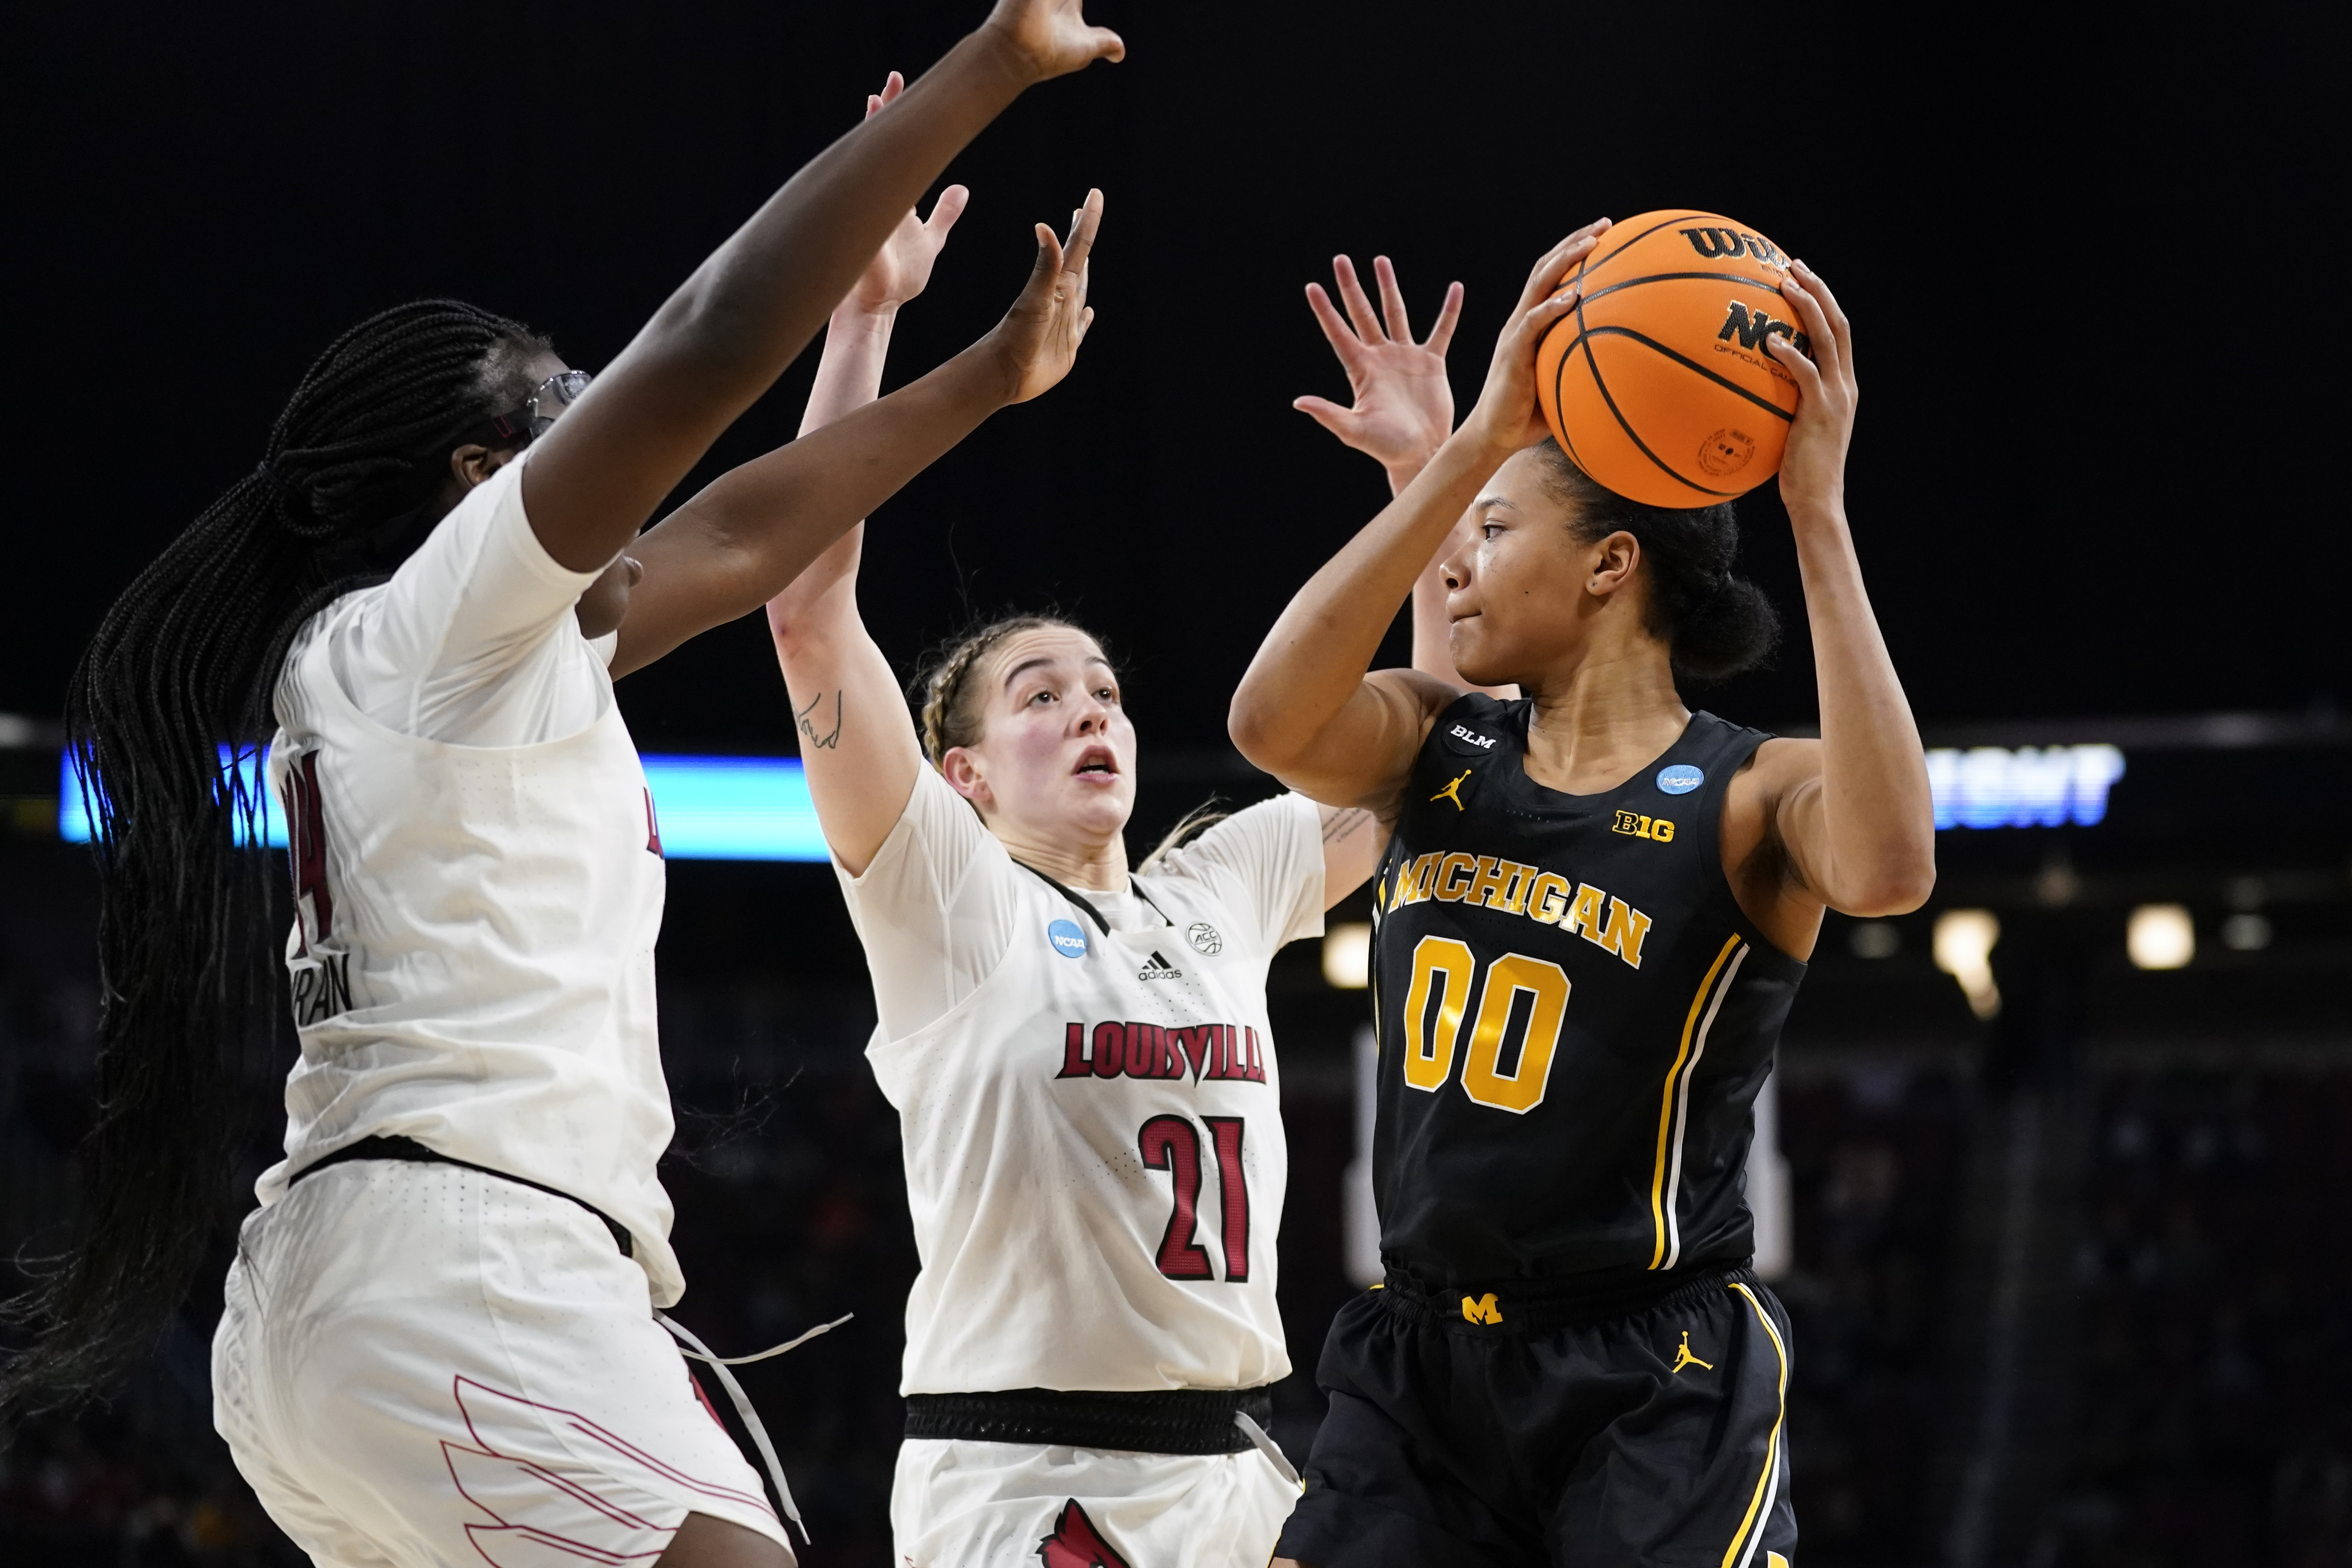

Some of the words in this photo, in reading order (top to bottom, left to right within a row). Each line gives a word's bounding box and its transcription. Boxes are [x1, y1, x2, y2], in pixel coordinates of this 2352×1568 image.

[1450, 724, 1496, 749] BLM
[1662, 778, 1700, 786] NCAA
[1388, 850, 1653, 970] MICHIGAN
[1055, 935, 1085, 949] NCAA
[1195, 930, 1217, 944] ACC
[1138, 969, 1182, 981] adidas
[1403, 934, 1572, 1115] 00
[1137, 1113, 1250, 1283] 21
[1461, 1293, 1503, 1326] M
